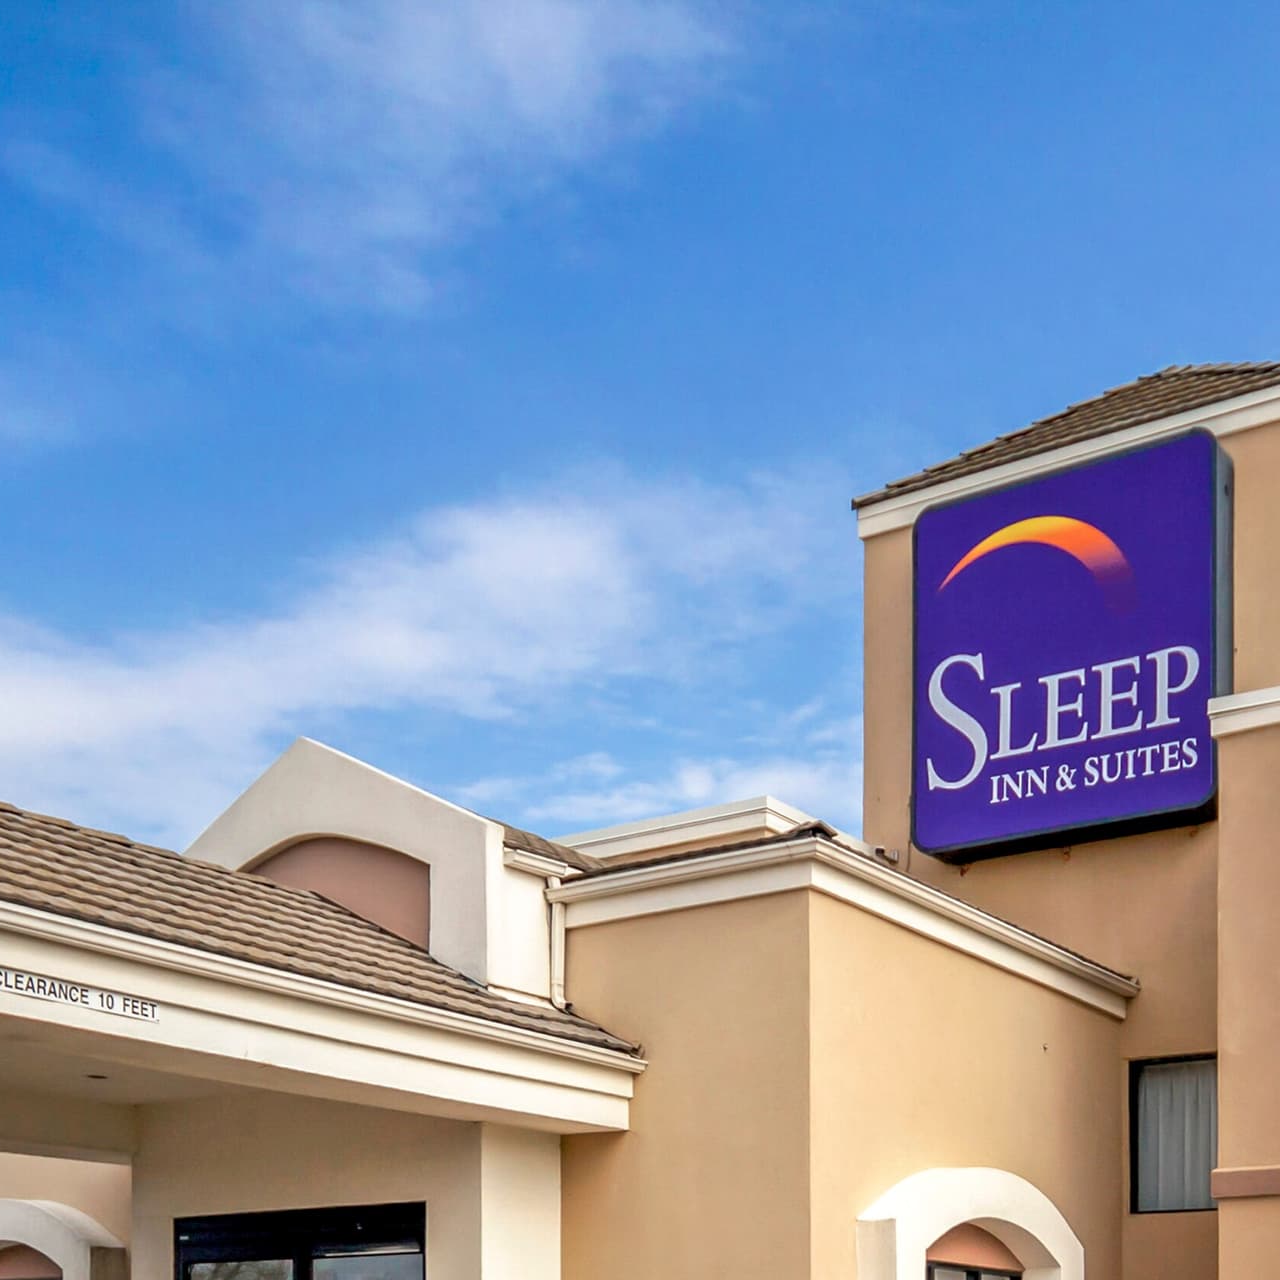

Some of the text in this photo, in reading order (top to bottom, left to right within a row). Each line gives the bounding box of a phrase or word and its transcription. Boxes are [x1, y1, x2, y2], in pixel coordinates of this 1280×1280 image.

[926, 645, 1201, 791] SLEEP
[990, 737, 1199, 804] INN & SUITES
[98, 992, 115, 1010] 10
[122, 997, 157, 1018] FEET
